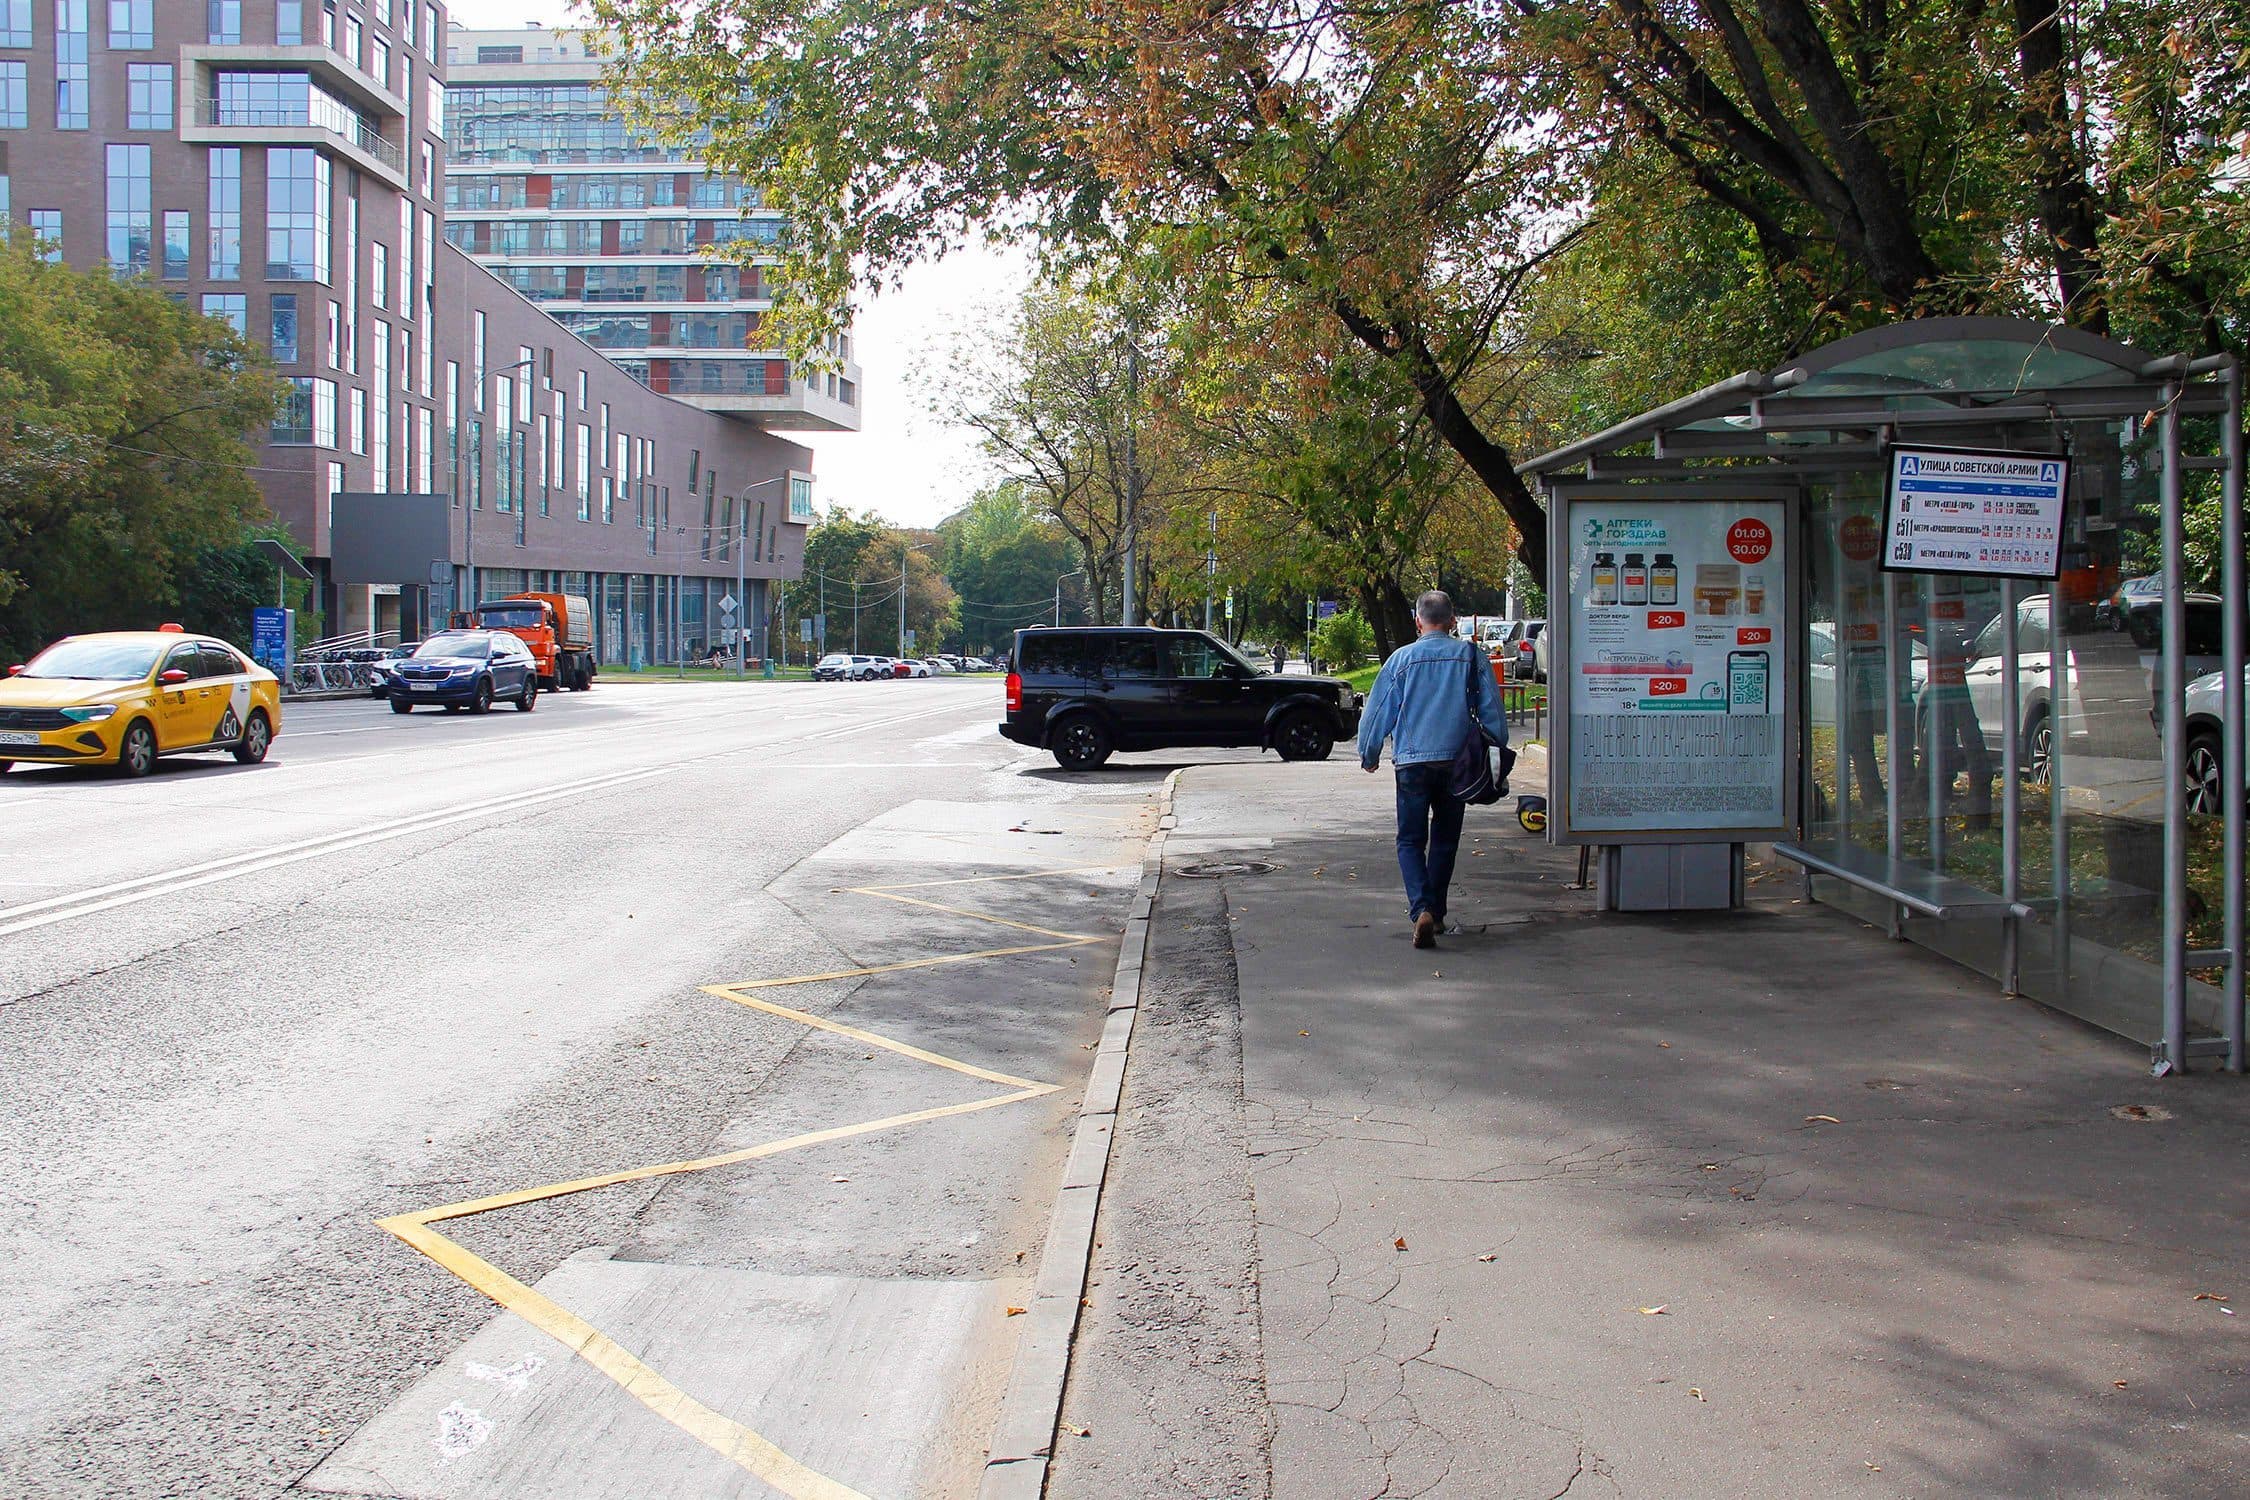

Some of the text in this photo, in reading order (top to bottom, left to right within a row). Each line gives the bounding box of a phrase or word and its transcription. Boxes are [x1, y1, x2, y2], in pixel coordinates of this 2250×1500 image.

[1920, 460, 2038, 476] УЛИЦА СОВЕТСКОЙ АРМИИ
[1924, 500, 1940, 508] МЕТРО
[1606, 519, 1652, 528] АПТЕКИ
[1896, 518, 1913, 536] с511
[1913, 524, 1930, 532] МЕТРО
[1606, 529, 1667, 539] ГОРЗДРАВ
[1734, 528, 1765, 539] 01.09
[1732, 544, 1766, 555] 30.09
[1920, 549, 1936, 558] МЕТРО
[1622, 701, 1637, 709] 18+
[222, 710, 237, 737] Go
